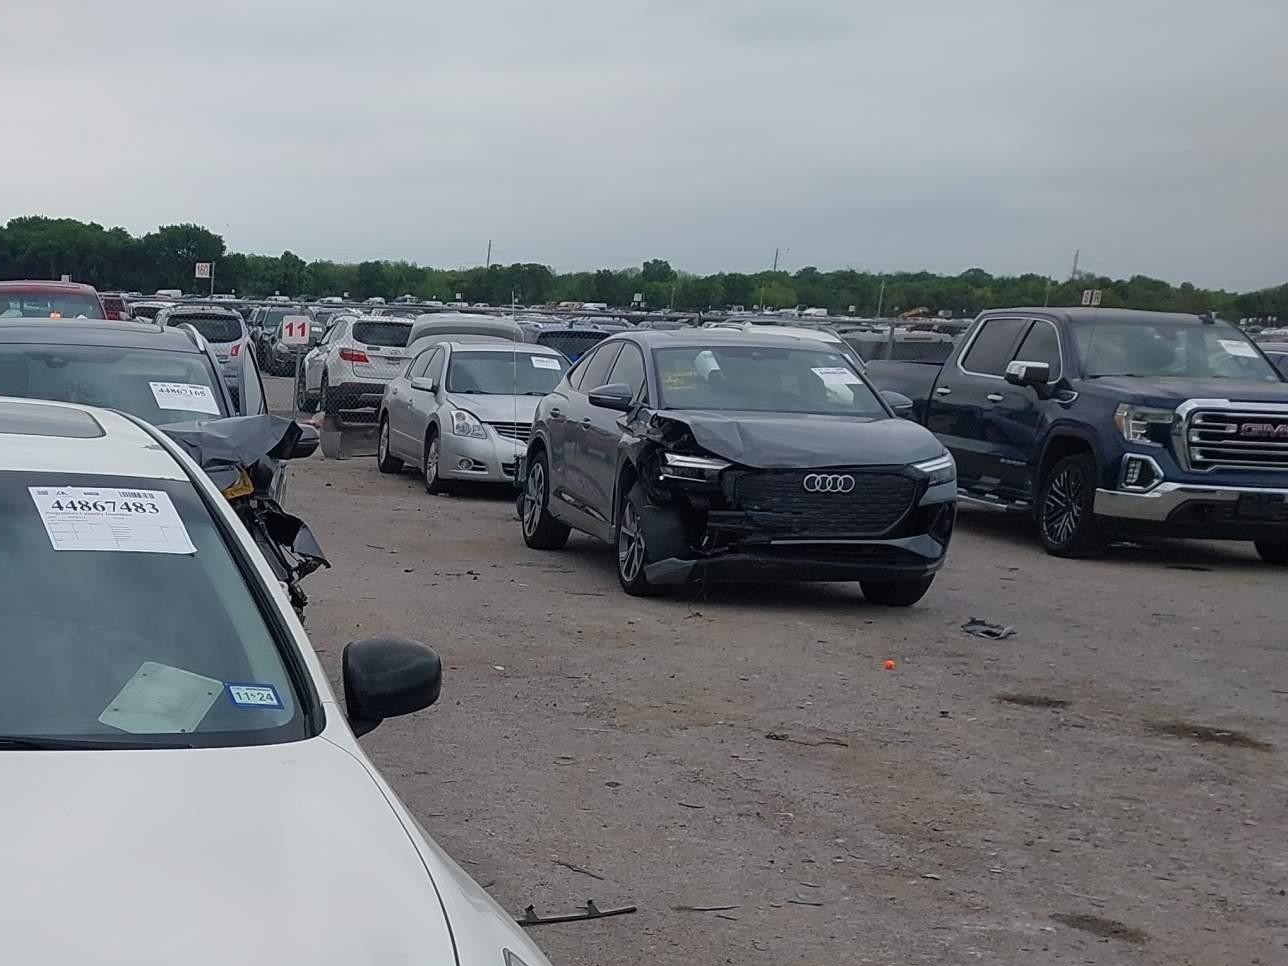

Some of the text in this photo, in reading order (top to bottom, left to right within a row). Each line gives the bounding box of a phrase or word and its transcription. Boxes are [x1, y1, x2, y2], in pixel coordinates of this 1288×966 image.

[285, 322, 306, 337] 11
[1241, 423, 1288, 436] GM
[51, 499, 160, 514] 44867483
